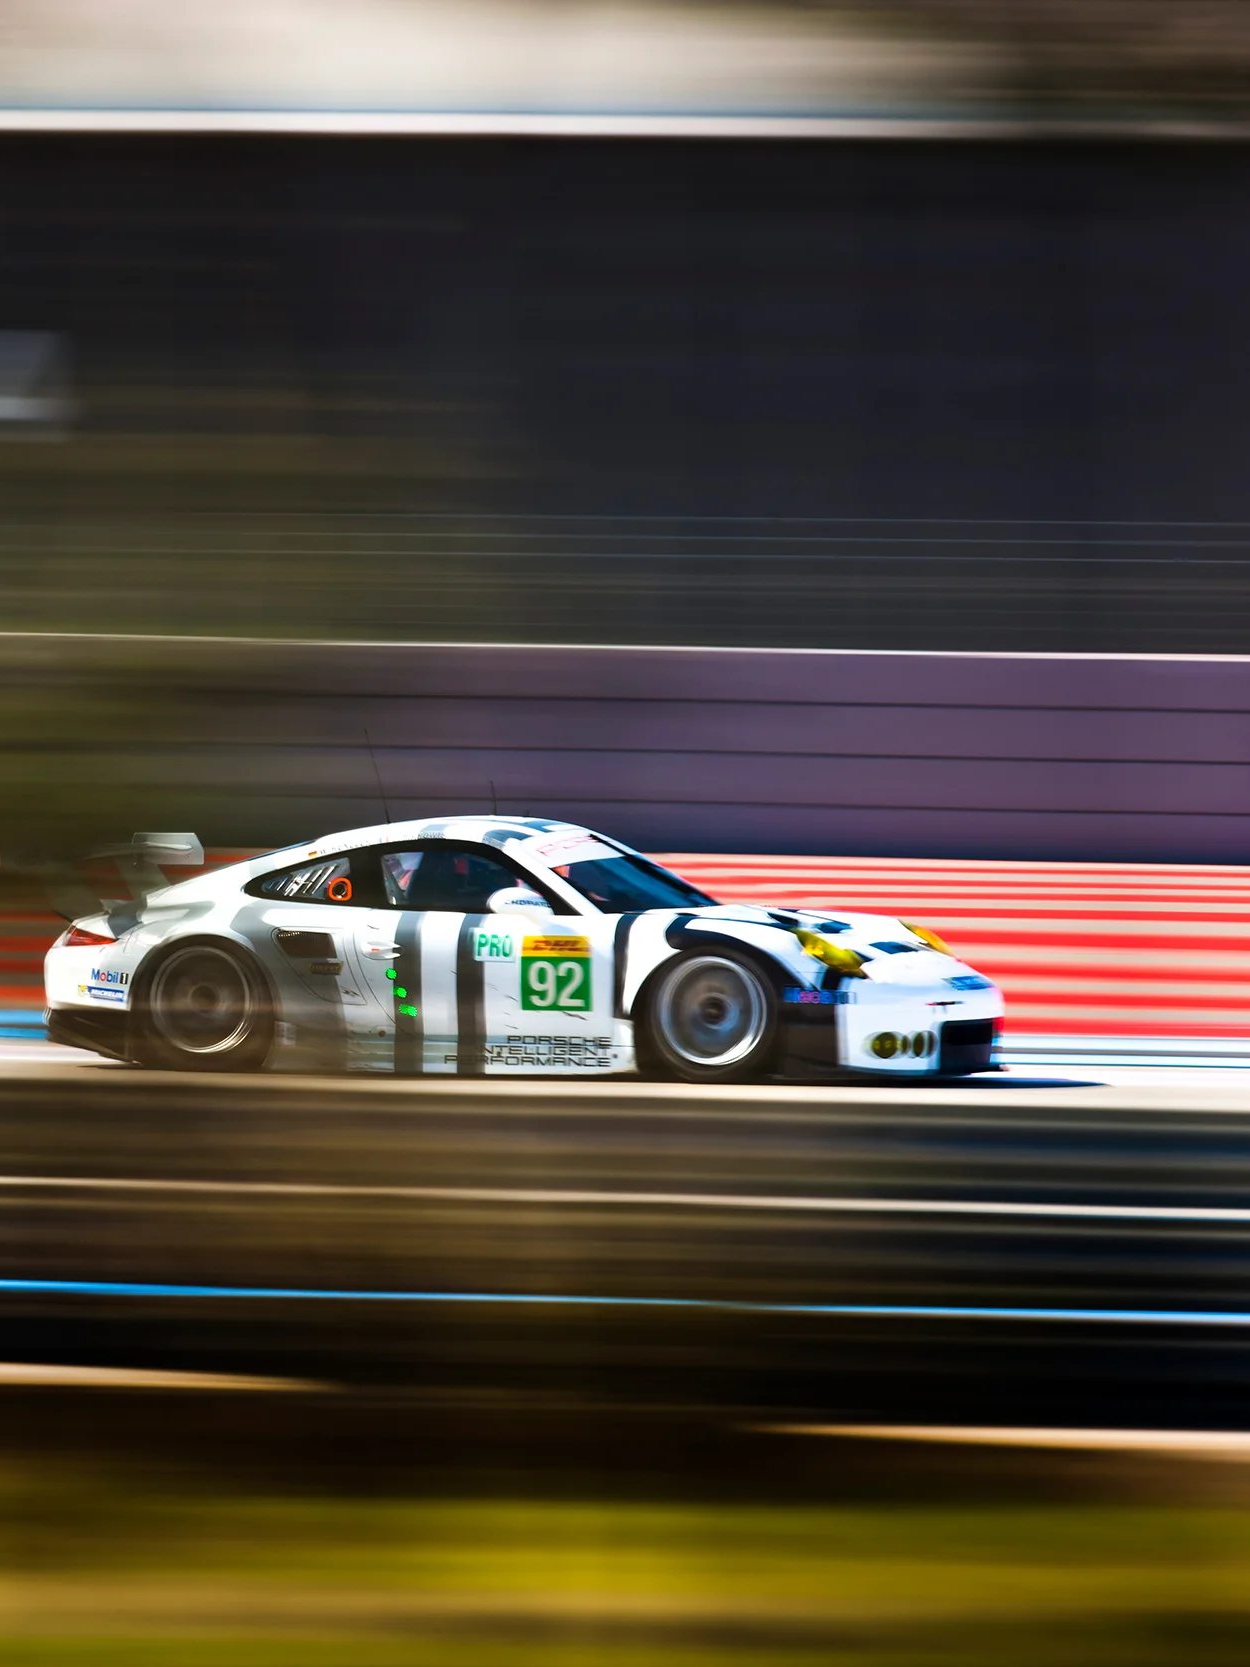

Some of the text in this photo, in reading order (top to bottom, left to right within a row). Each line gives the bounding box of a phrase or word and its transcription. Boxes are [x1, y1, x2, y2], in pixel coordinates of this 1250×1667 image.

[476, 933, 513, 957] PRO
[91, 968, 129, 984] Mobil 1
[528, 960, 586, 1007] 92
[507, 1035, 611, 1046] PORSCHE
[480, 1044, 608, 1056] NTELLIGENT
[444, 1054, 611, 1068] PERFORMANCE
